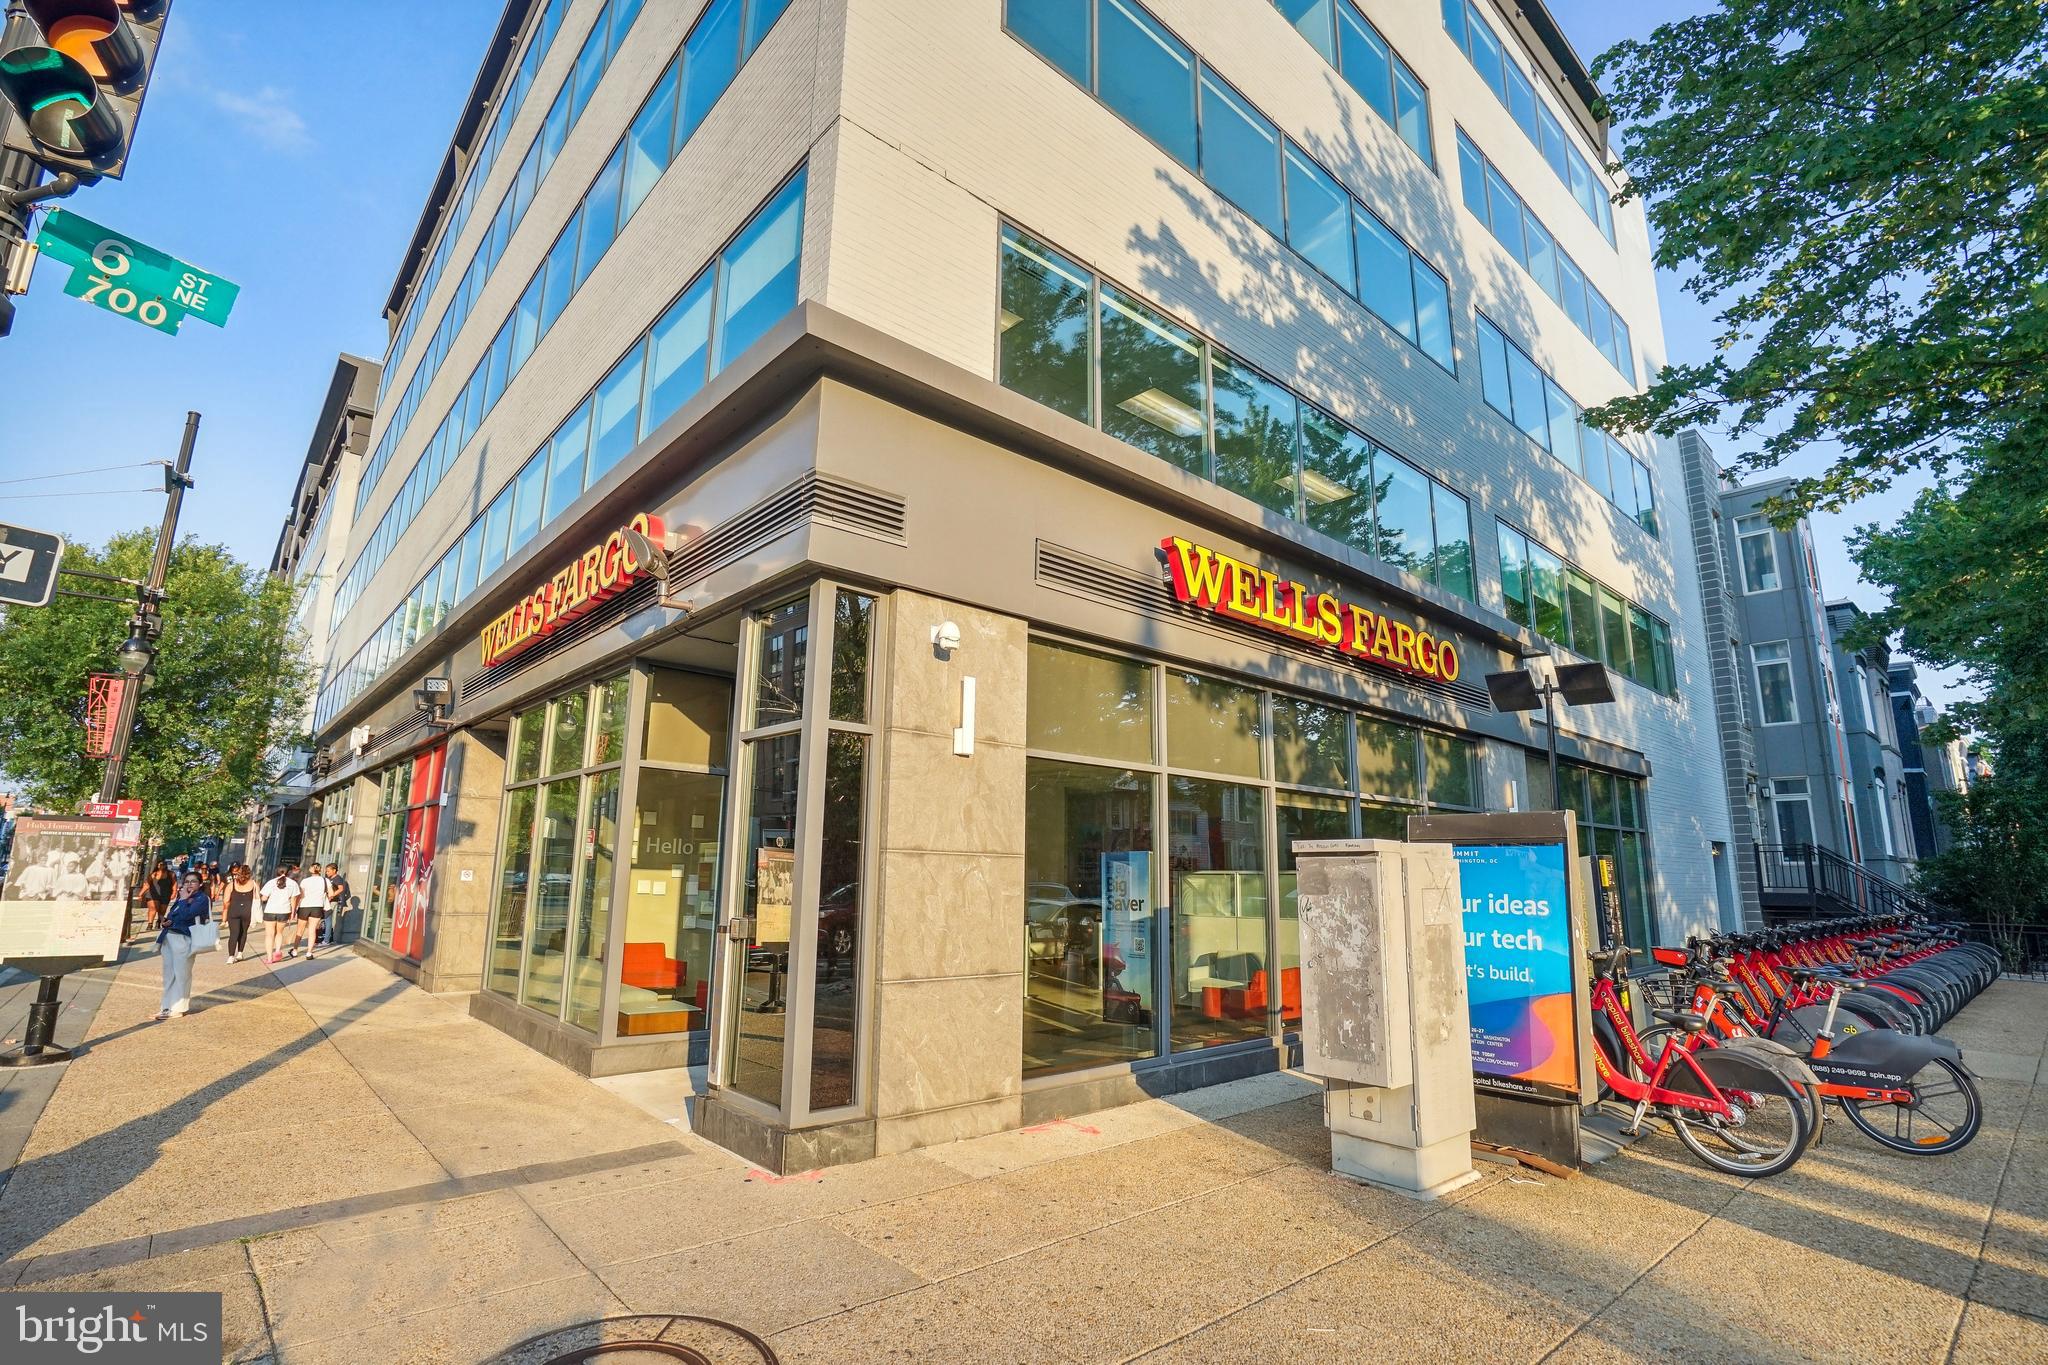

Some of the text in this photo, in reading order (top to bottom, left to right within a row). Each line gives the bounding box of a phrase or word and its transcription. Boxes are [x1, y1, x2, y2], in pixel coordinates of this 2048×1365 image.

[92, 239, 212, 294] 6 ST
[81, 275, 167, 326] 700
[172, 286, 209, 312] NE
[480, 512, 649, 667] WELLS FARGO
[1170, 536, 1459, 683] WELLS FARGO
[646, 837, 693, 854] Hello
[1107, 877, 1127, 897] Big
[1107, 898, 1145, 912] Saver
[1461, 893, 1550, 916] ur ideas
[1463, 929, 1543, 951] ur tech
[1466, 964, 1534, 983] t's build.
[1605, 997, 1644, 1065] capital bikeshare
[1473, 1077, 1491, 1086] apital
[1812, 1064, 1830, 1074] (888)
[1869, 1072, 1902, 1082] spin.app
